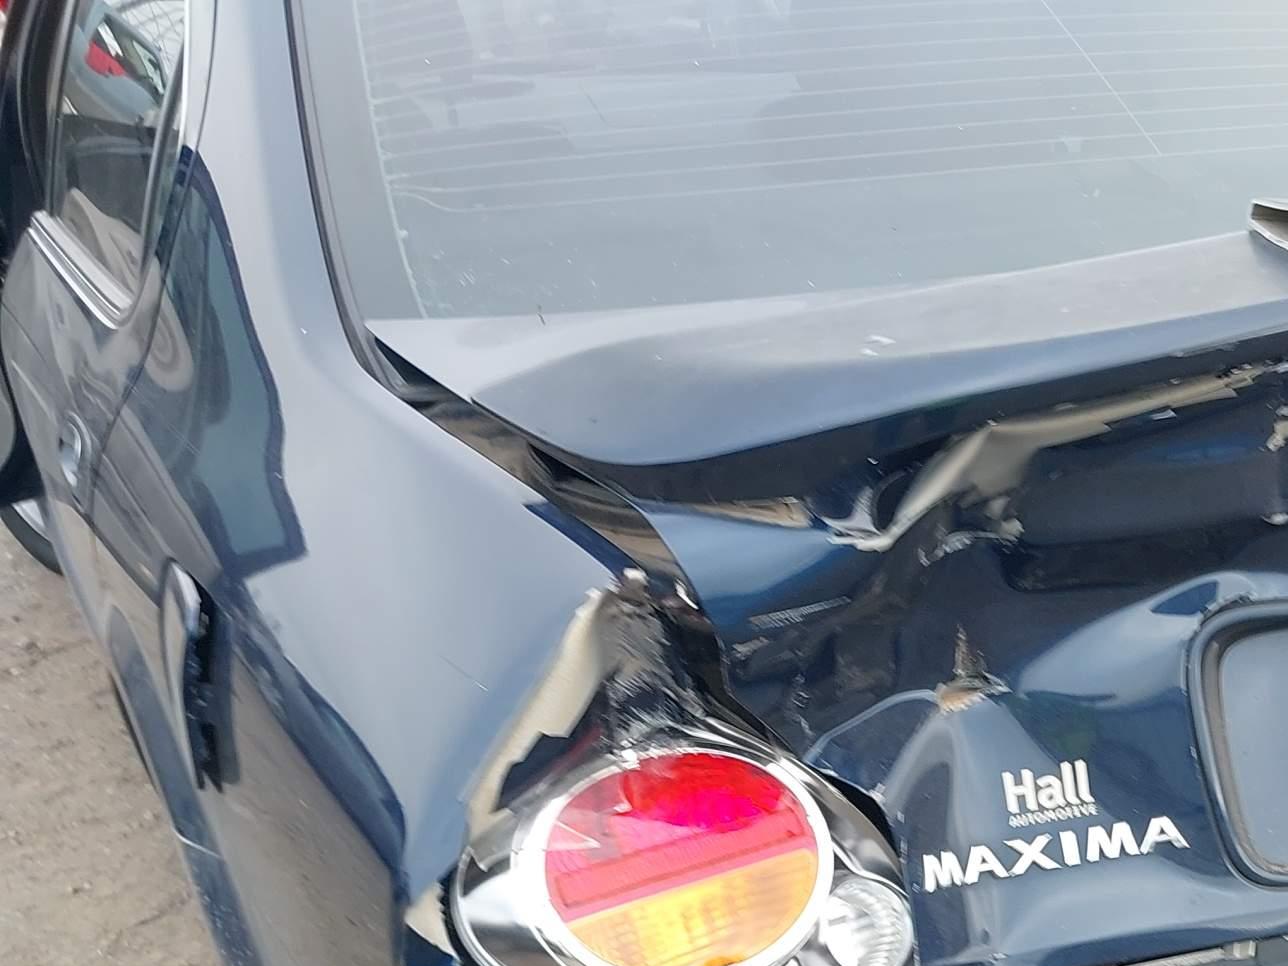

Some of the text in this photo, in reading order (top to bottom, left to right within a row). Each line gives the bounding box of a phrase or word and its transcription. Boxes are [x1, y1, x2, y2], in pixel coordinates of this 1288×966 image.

[1001, 758, 1096, 814] Hall
[1007, 802, 1099, 829] AUTOMOTIVE
[921, 814, 1192, 894] MAXIMA
